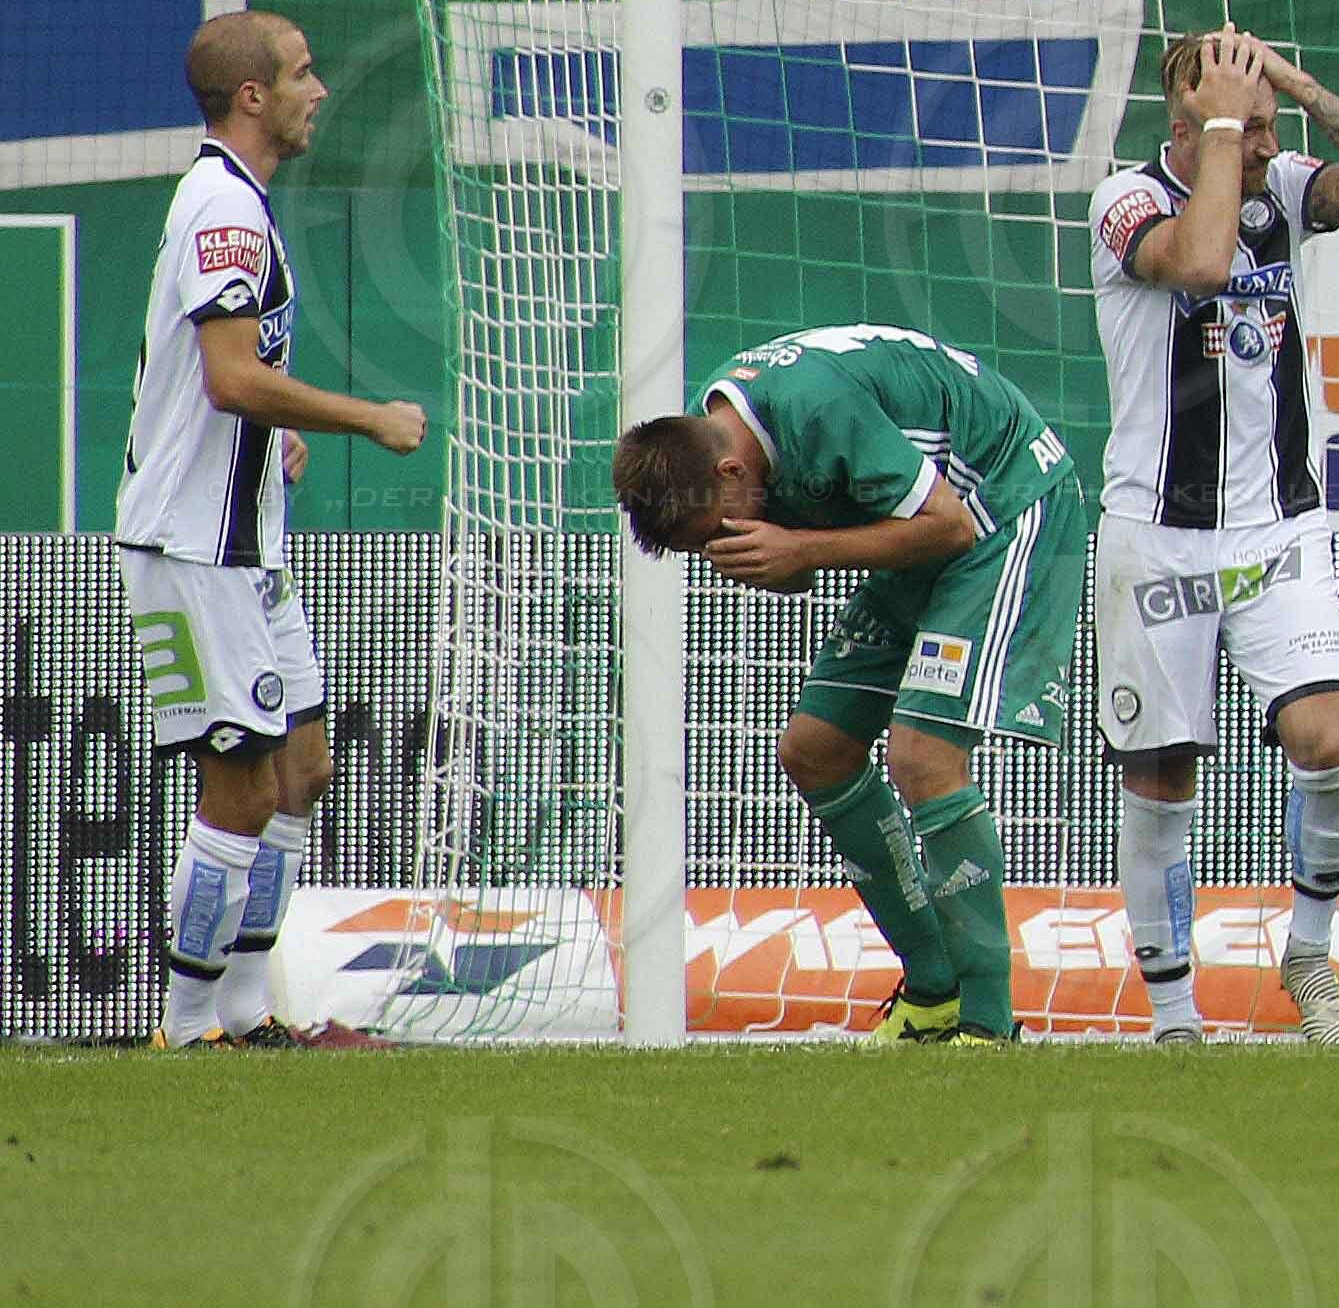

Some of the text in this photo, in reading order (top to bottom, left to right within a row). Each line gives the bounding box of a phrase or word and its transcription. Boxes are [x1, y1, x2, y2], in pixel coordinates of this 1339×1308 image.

[200, 229, 264, 252] KLEIN
[1142, 550, 1292, 621] GRAZ
[684, 907, 905, 971] WIE
